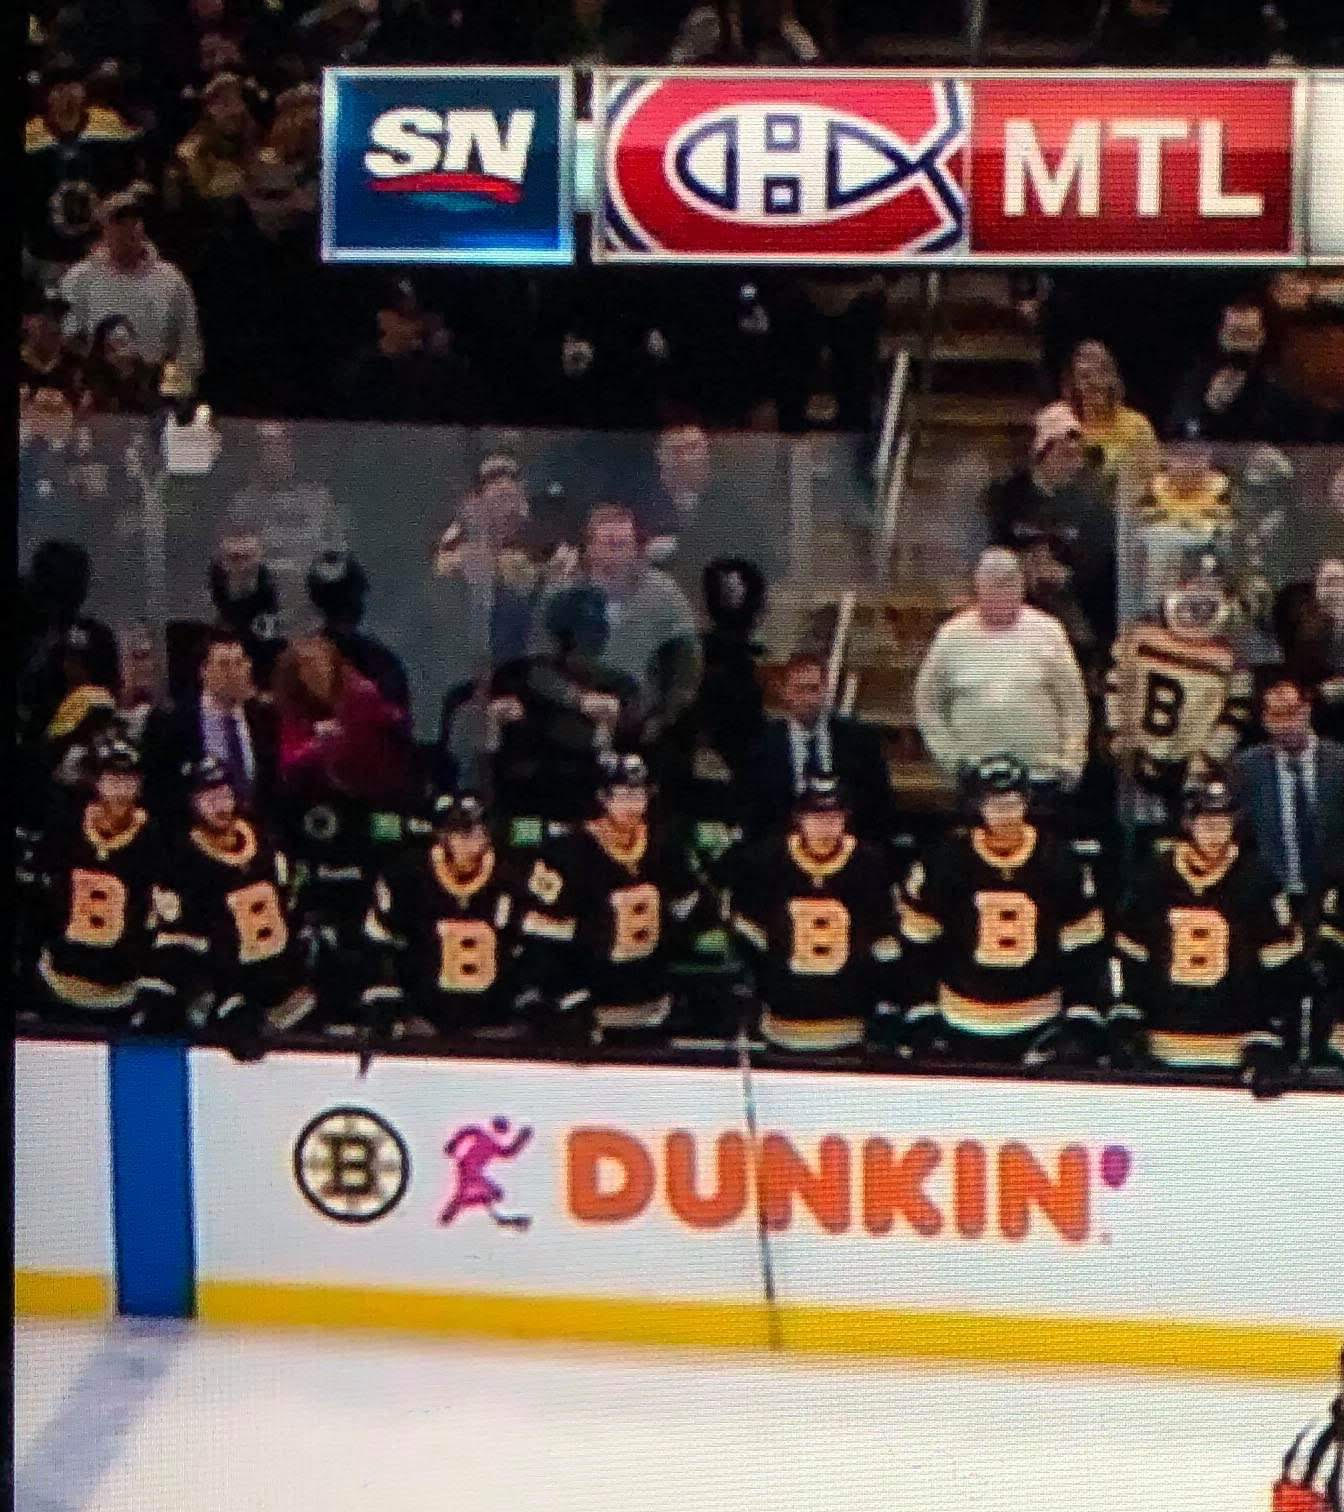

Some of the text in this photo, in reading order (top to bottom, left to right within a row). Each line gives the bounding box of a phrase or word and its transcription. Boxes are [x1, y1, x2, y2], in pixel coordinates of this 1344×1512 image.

[364, 106, 538, 180] SN
[1000, 117, 1264, 221] MTL
[65, 868, 128, 948] B
[226, 881, 288, 964] B
[609, 884, 661, 962] B
[787, 897, 850, 975] B
[973, 890, 1037, 968] B
[1168, 906, 1230, 987] B
[437, 919, 497, 992] B
